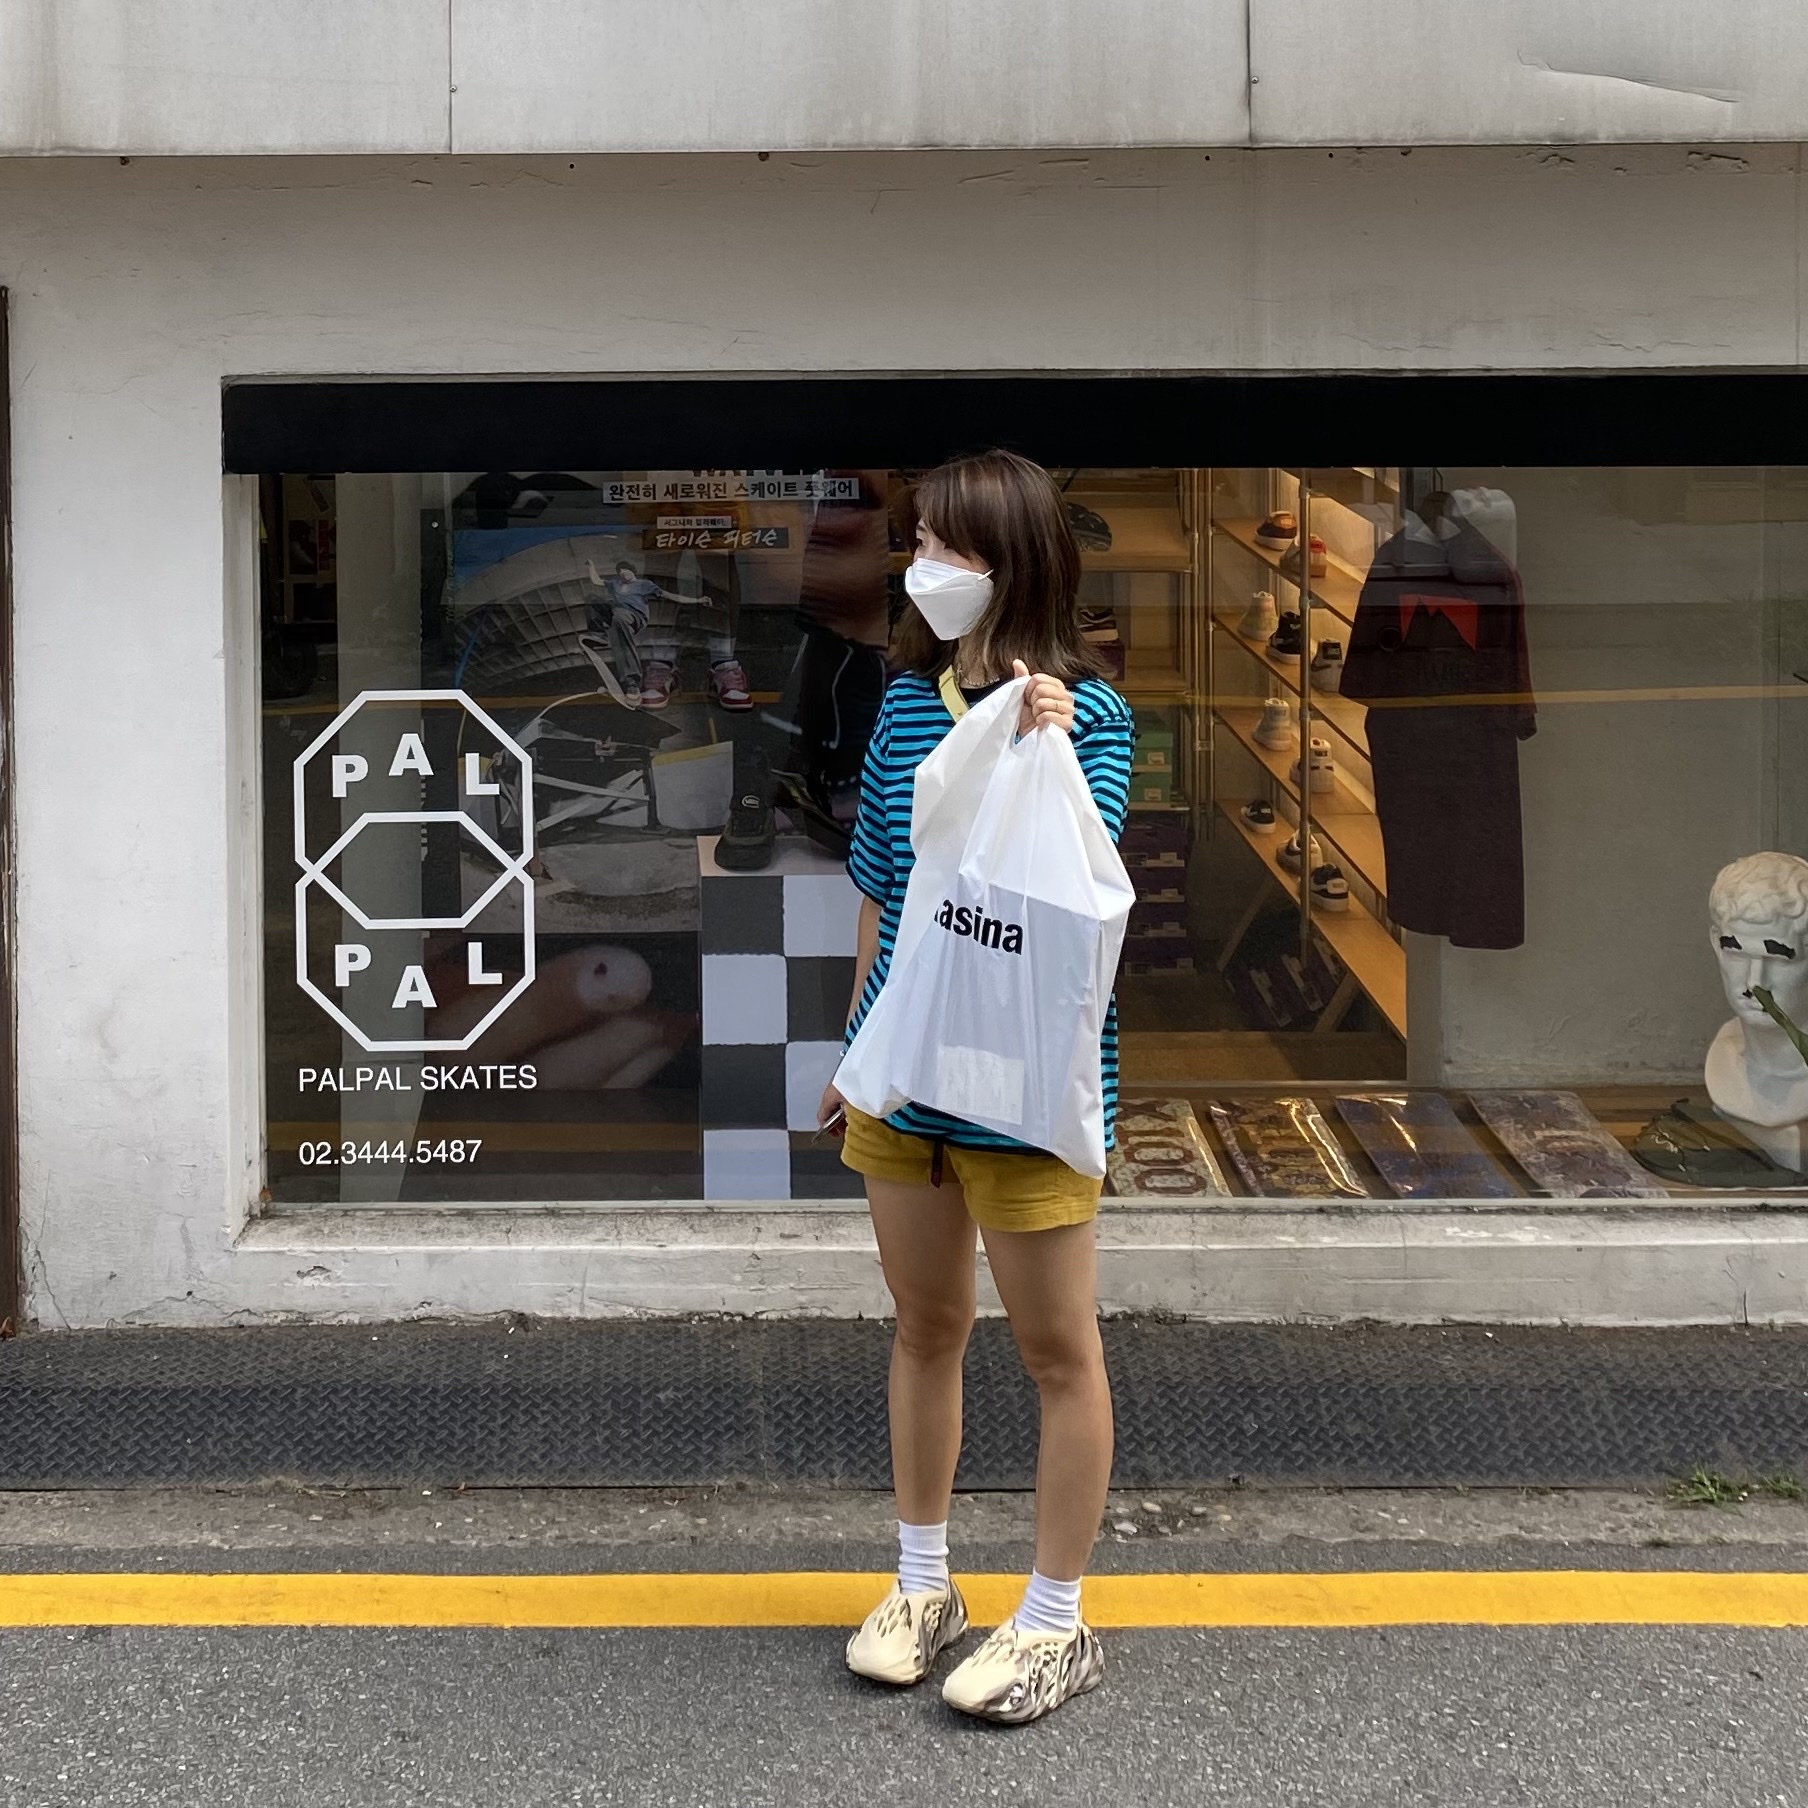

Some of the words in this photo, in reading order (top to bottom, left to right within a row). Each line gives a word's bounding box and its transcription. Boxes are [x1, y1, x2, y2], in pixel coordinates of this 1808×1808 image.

[609, 483, 656, 500] 완전히
[663, 482, 727, 500] 새로워진
[734, 481, 799, 499] 스케이트
[656, 530, 712, 548] 타이슨
[723, 529, 778, 548] 피터슨
[331, 733, 500, 798] PAL
[934, 898, 1023, 956] asina
[334, 942, 503, 1009] PAL
[299, 1067, 411, 1092] PALPAL
[420, 1065, 538, 1090] SKATES
[299, 1139, 482, 1165] 02.3444.5487
